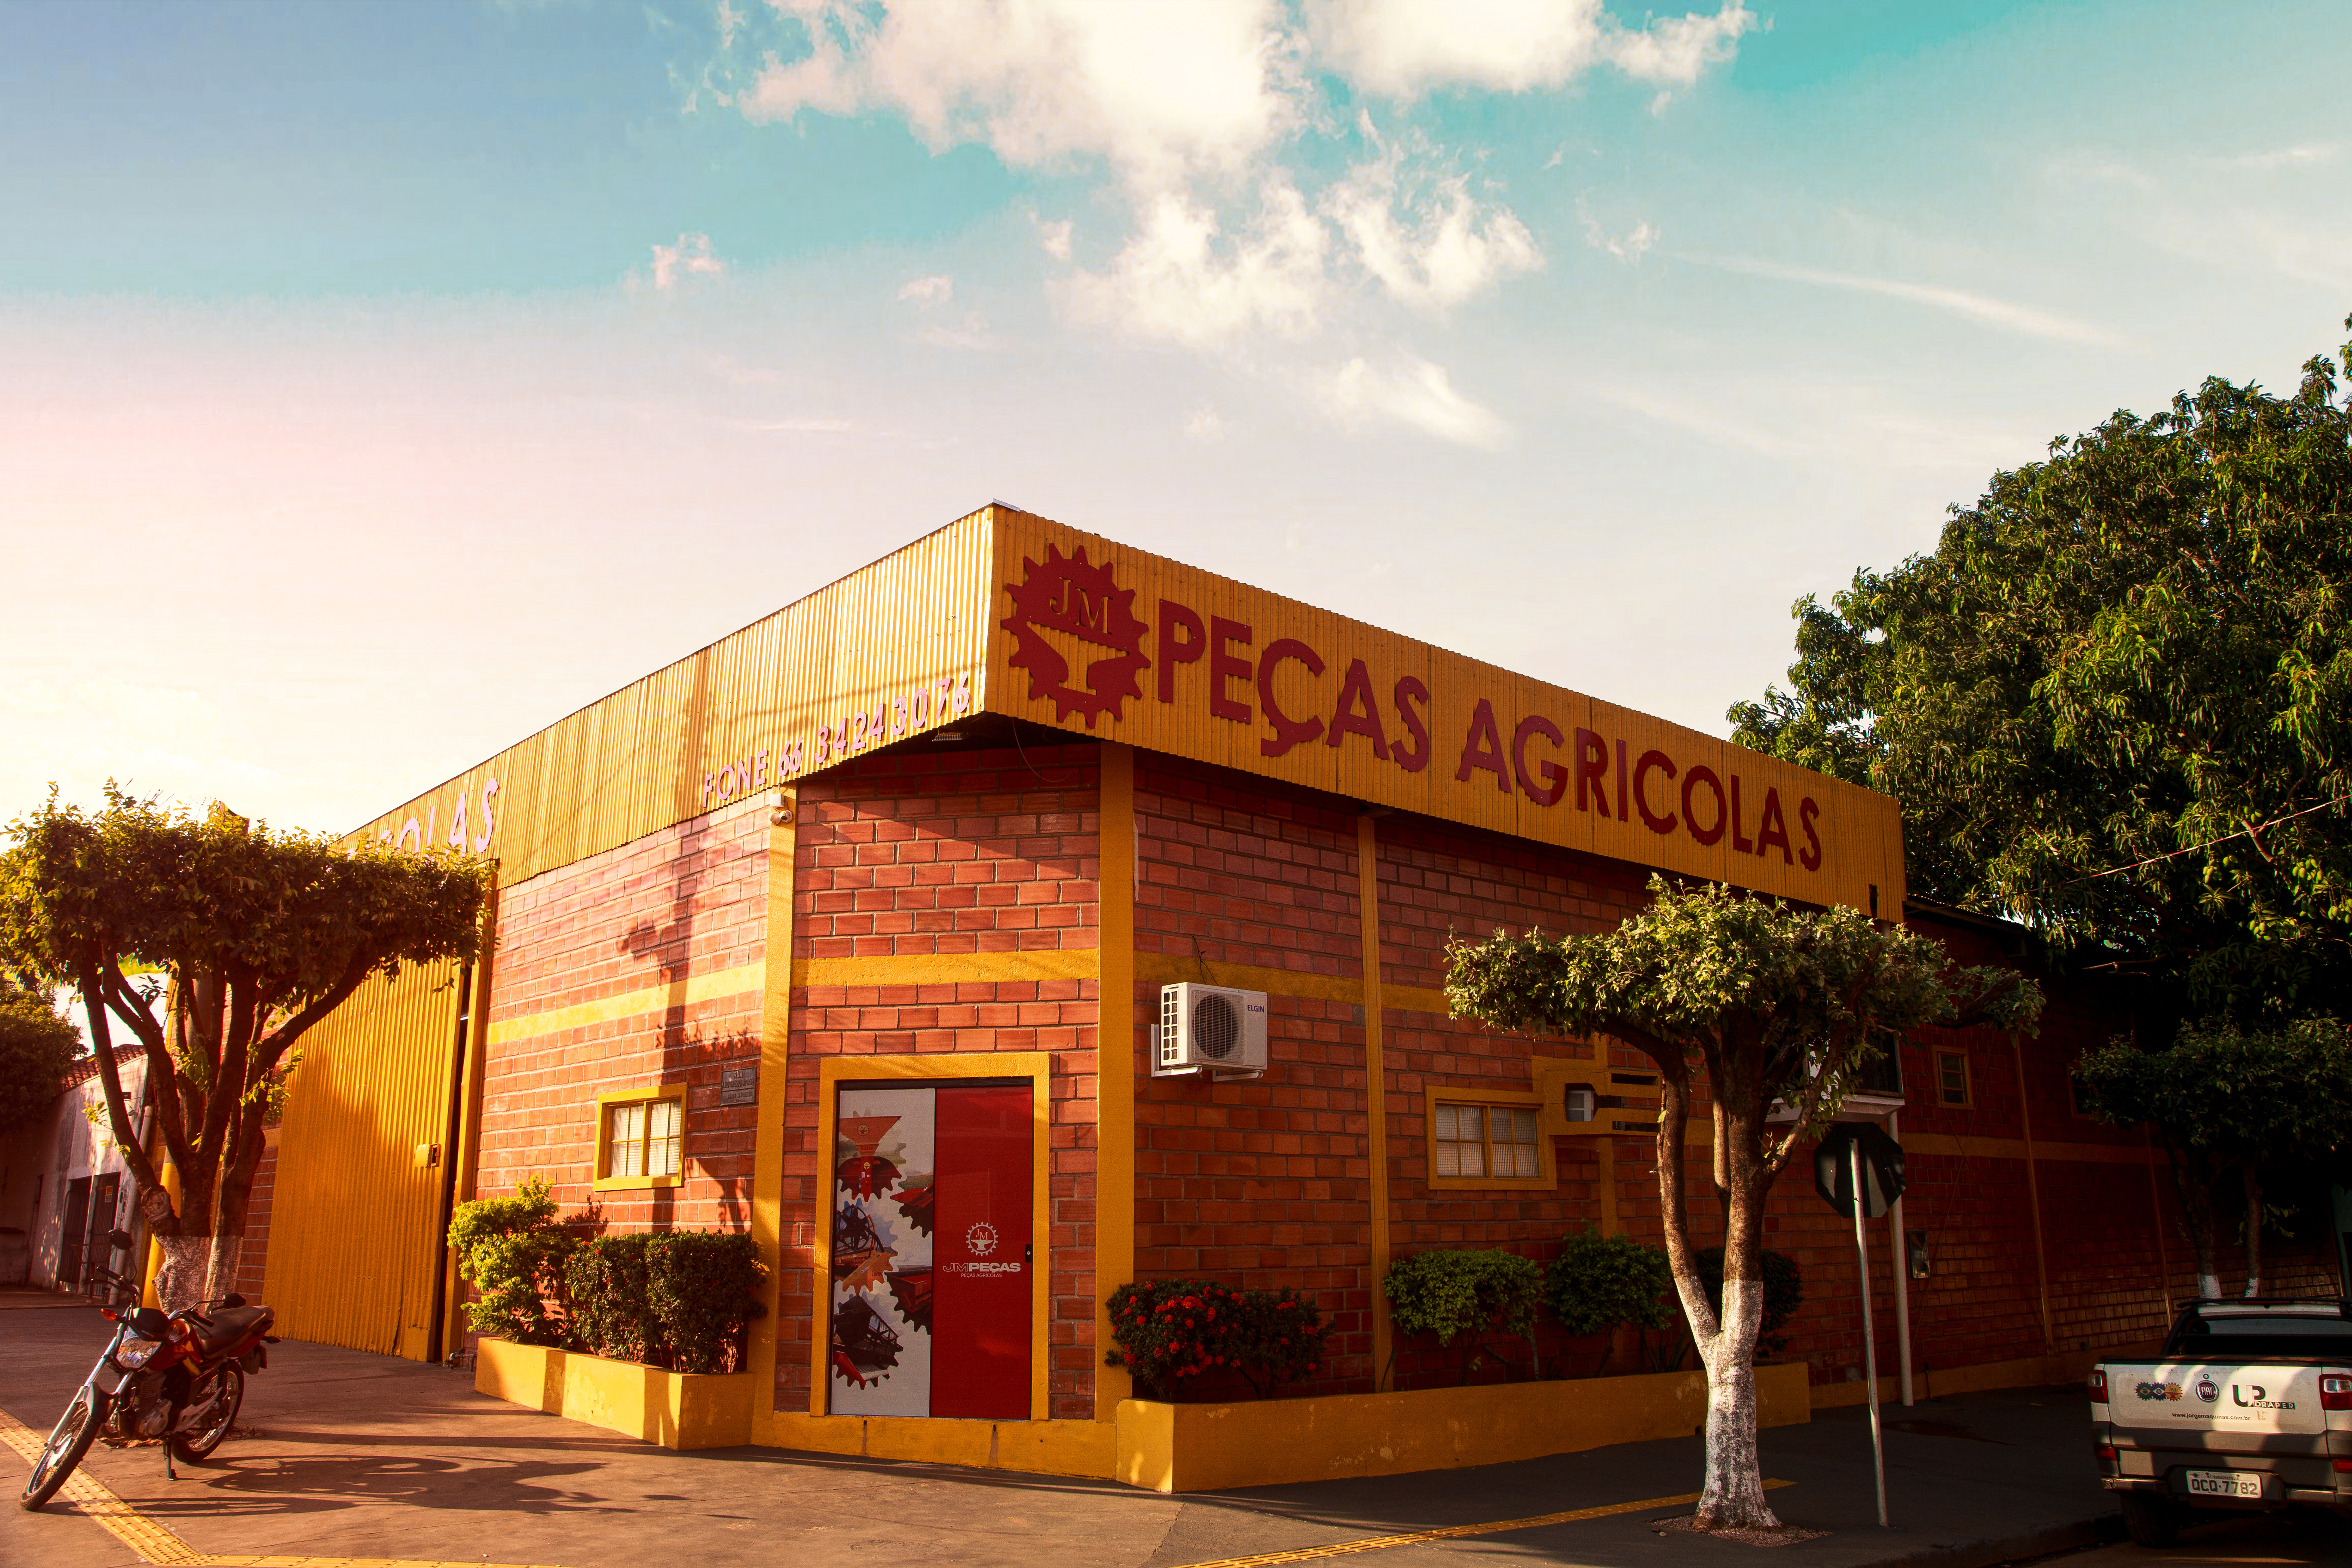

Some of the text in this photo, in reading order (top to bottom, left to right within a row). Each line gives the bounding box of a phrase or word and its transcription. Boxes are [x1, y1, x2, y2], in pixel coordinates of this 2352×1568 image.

[1050, 576, 1113, 635] JM
[1158, 598, 1821, 871] PEÇAS AGRICOLAS
[703, 750, 769, 808] FONE
[778, 736, 803, 777] 66
[1247, 1004, 1265, 1013] ELGIN
[976, 1229, 988, 1240] JM
[2201, 1387, 2213, 1396] FIAT
[2232, 1384, 2266, 1407] UP
[2254, 1401, 2295, 1409] DRAPER
